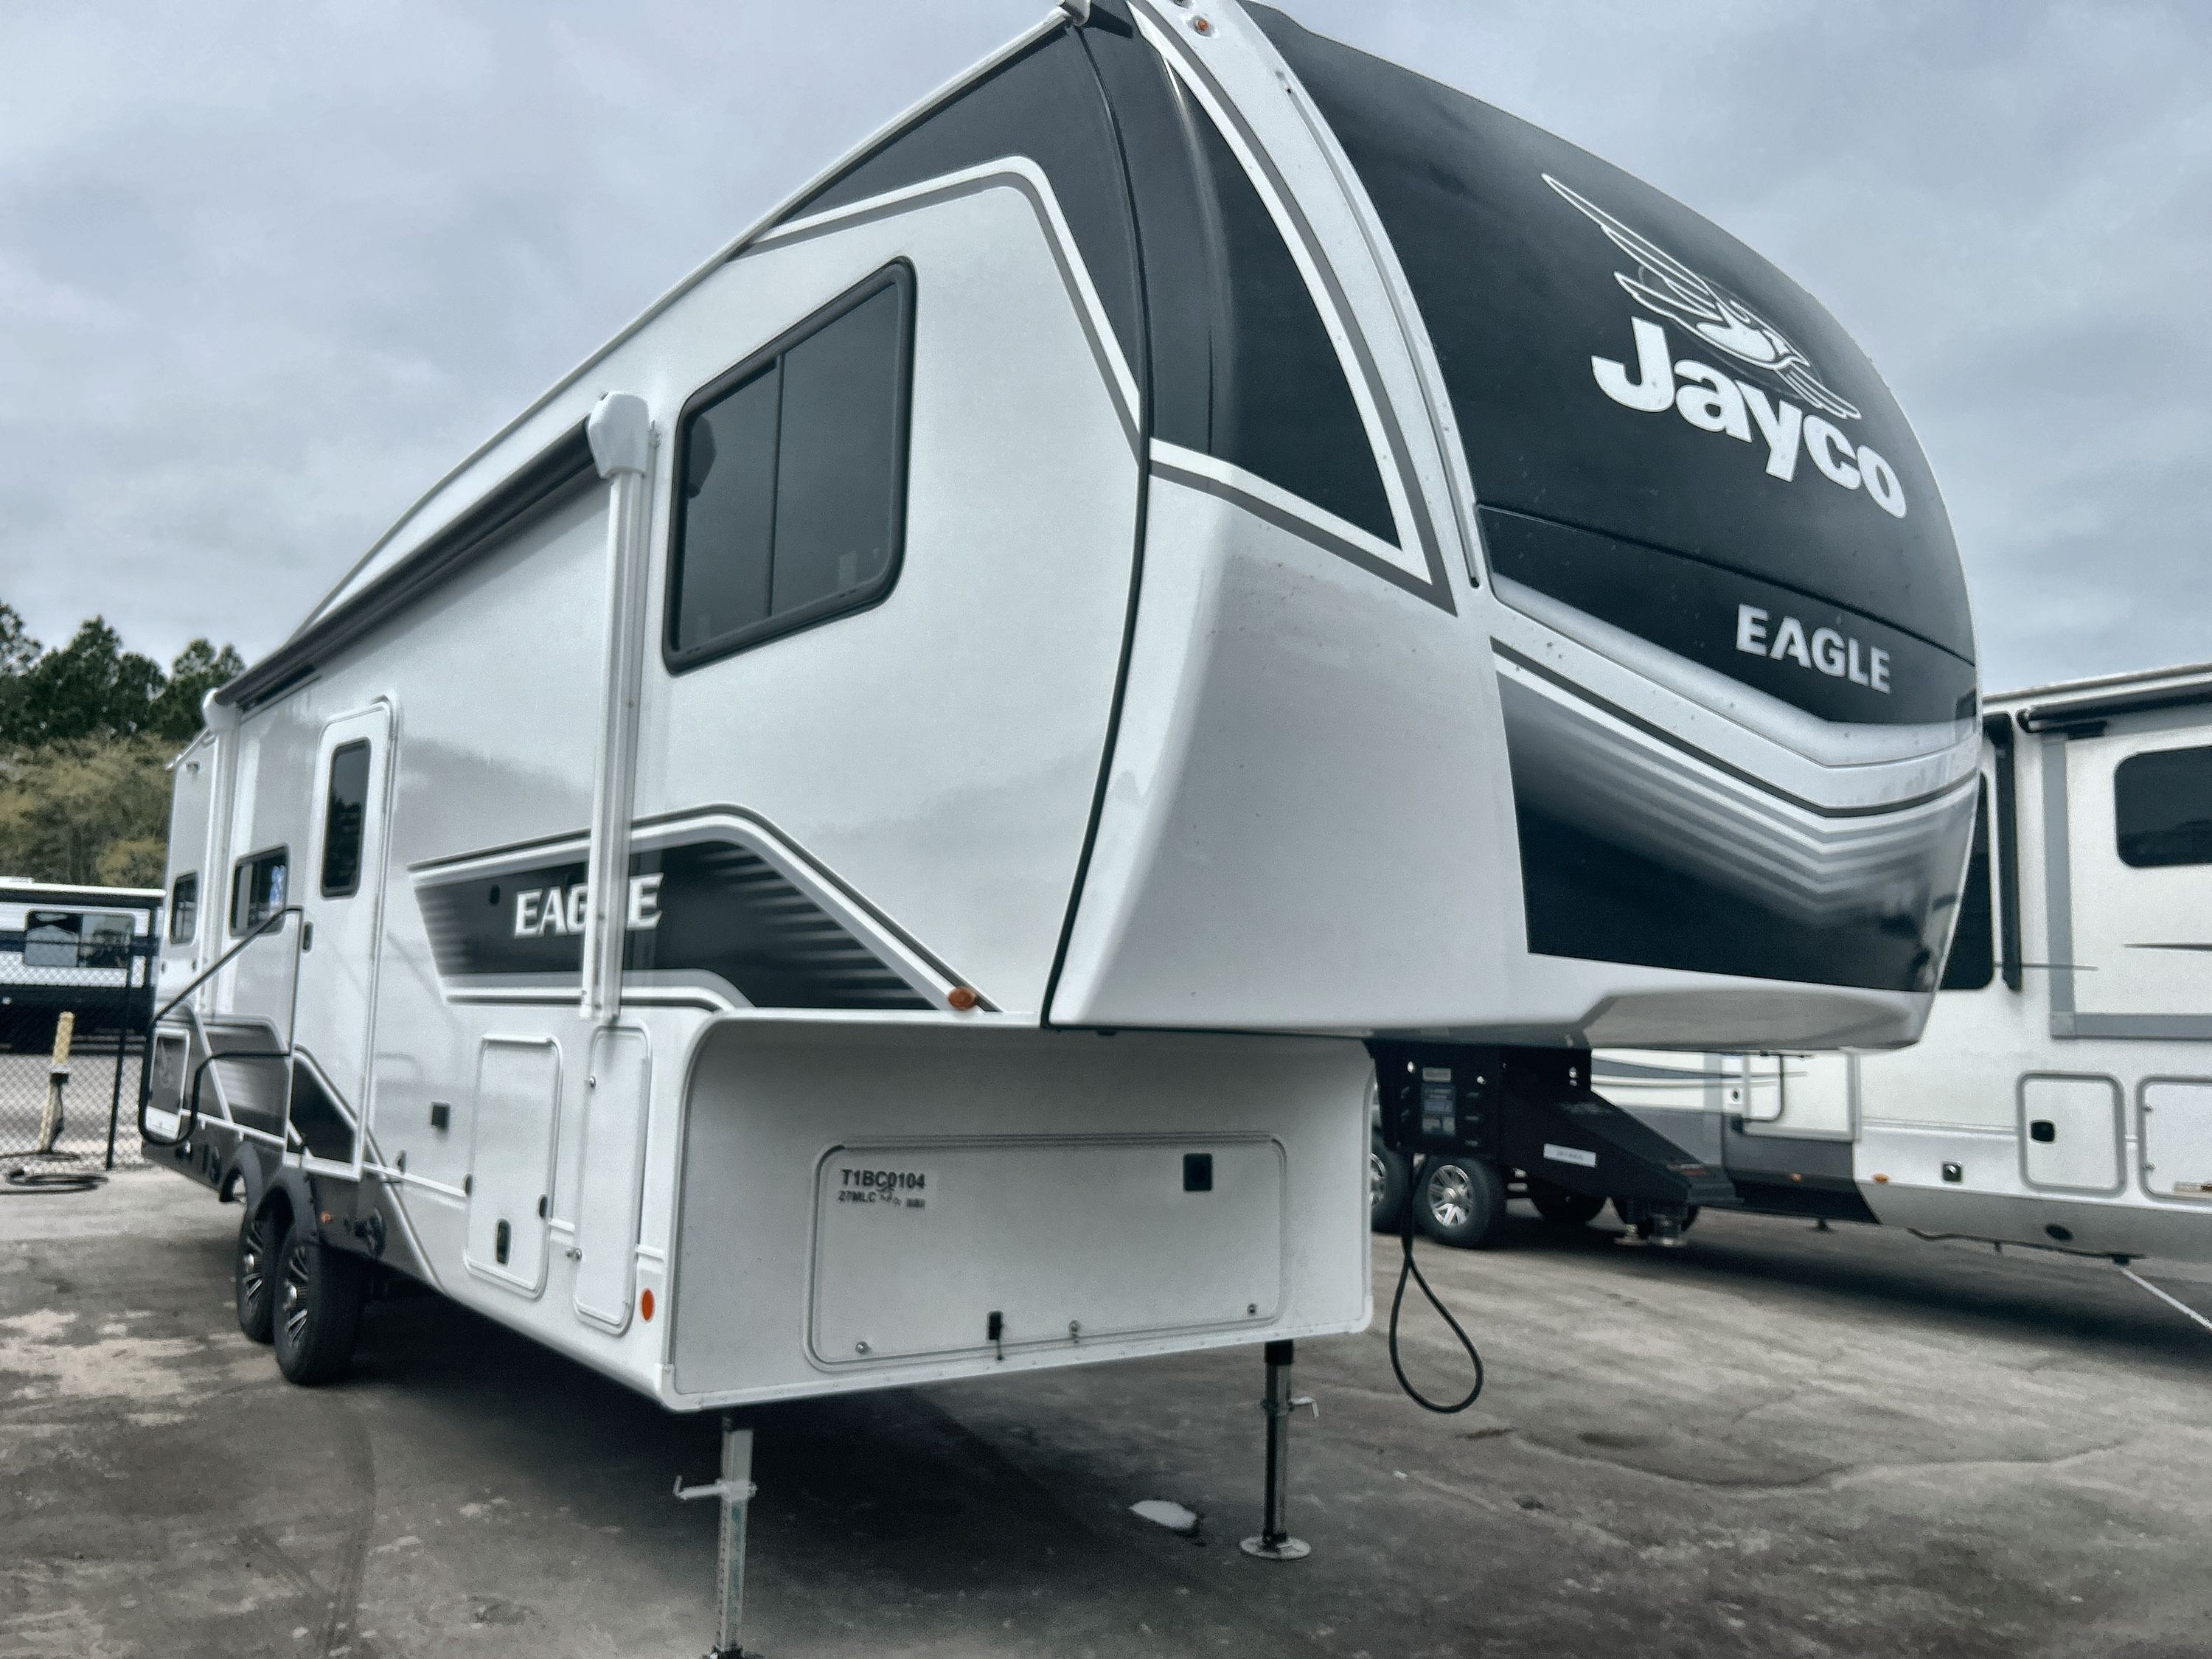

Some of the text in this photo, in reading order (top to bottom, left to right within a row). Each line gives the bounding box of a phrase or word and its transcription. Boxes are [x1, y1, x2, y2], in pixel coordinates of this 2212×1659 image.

[1590, 316, 1907, 519] Jayco
[1735, 603, 1892, 695] EAGLE
[514, 872, 664, 939] EAGE
[841, 1168, 926, 1189] T1BC0104
